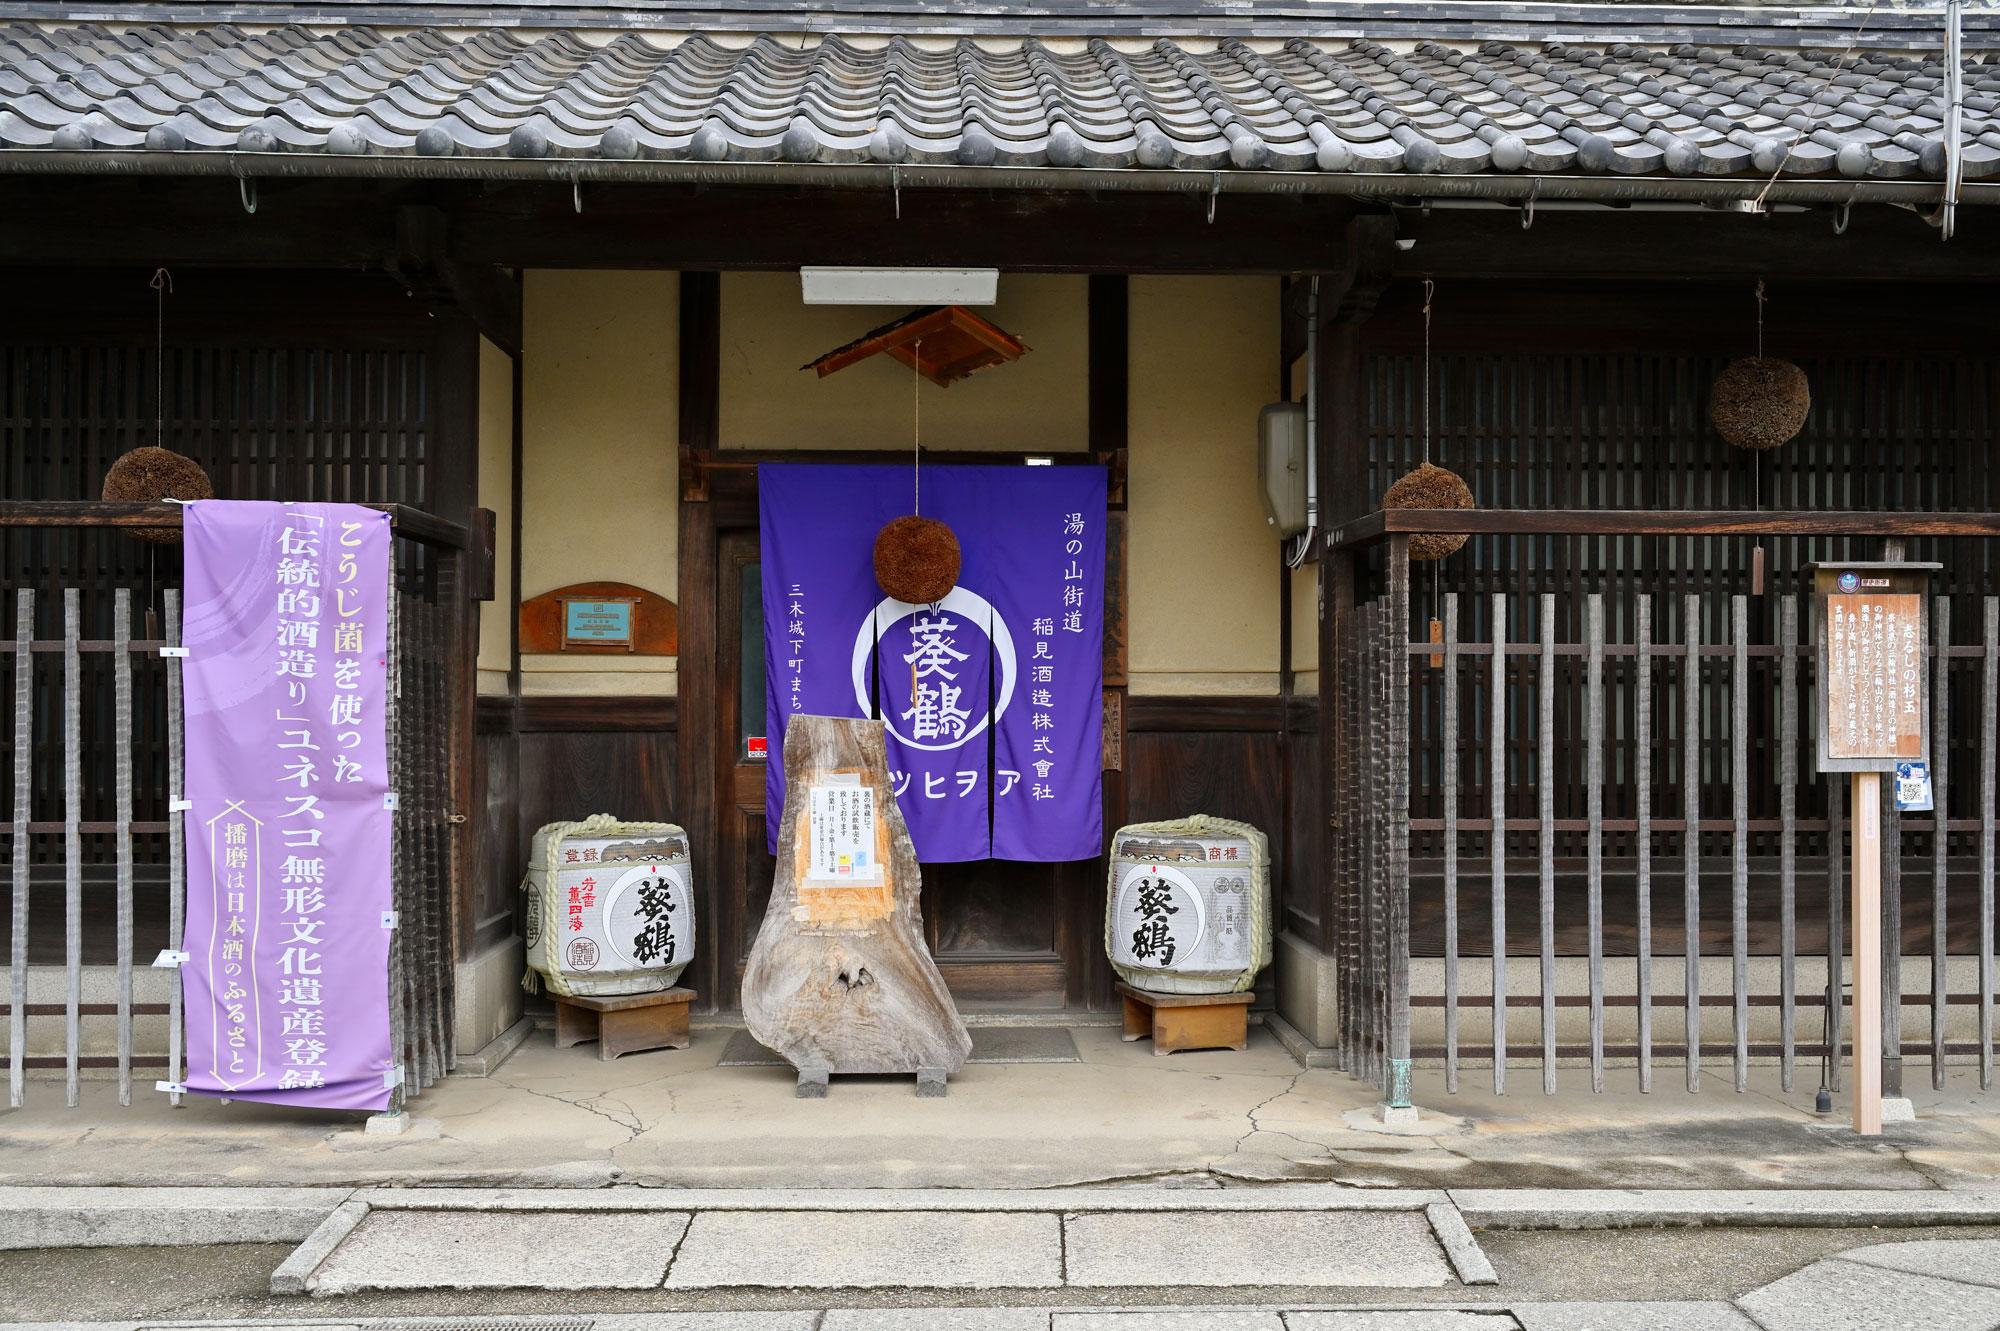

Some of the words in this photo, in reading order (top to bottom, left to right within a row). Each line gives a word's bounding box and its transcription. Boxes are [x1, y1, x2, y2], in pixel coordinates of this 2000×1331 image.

[329, 519, 364, 784] こうじ菌を使った
[1062, 512, 1086, 634] 湯の山街道
[1031, 617, 1055, 800] 稲見酒造株式會社
[1208, 847, 1239, 861] 商標
[222, 821, 248, 1075] 播磨は日本酒のふるさと
